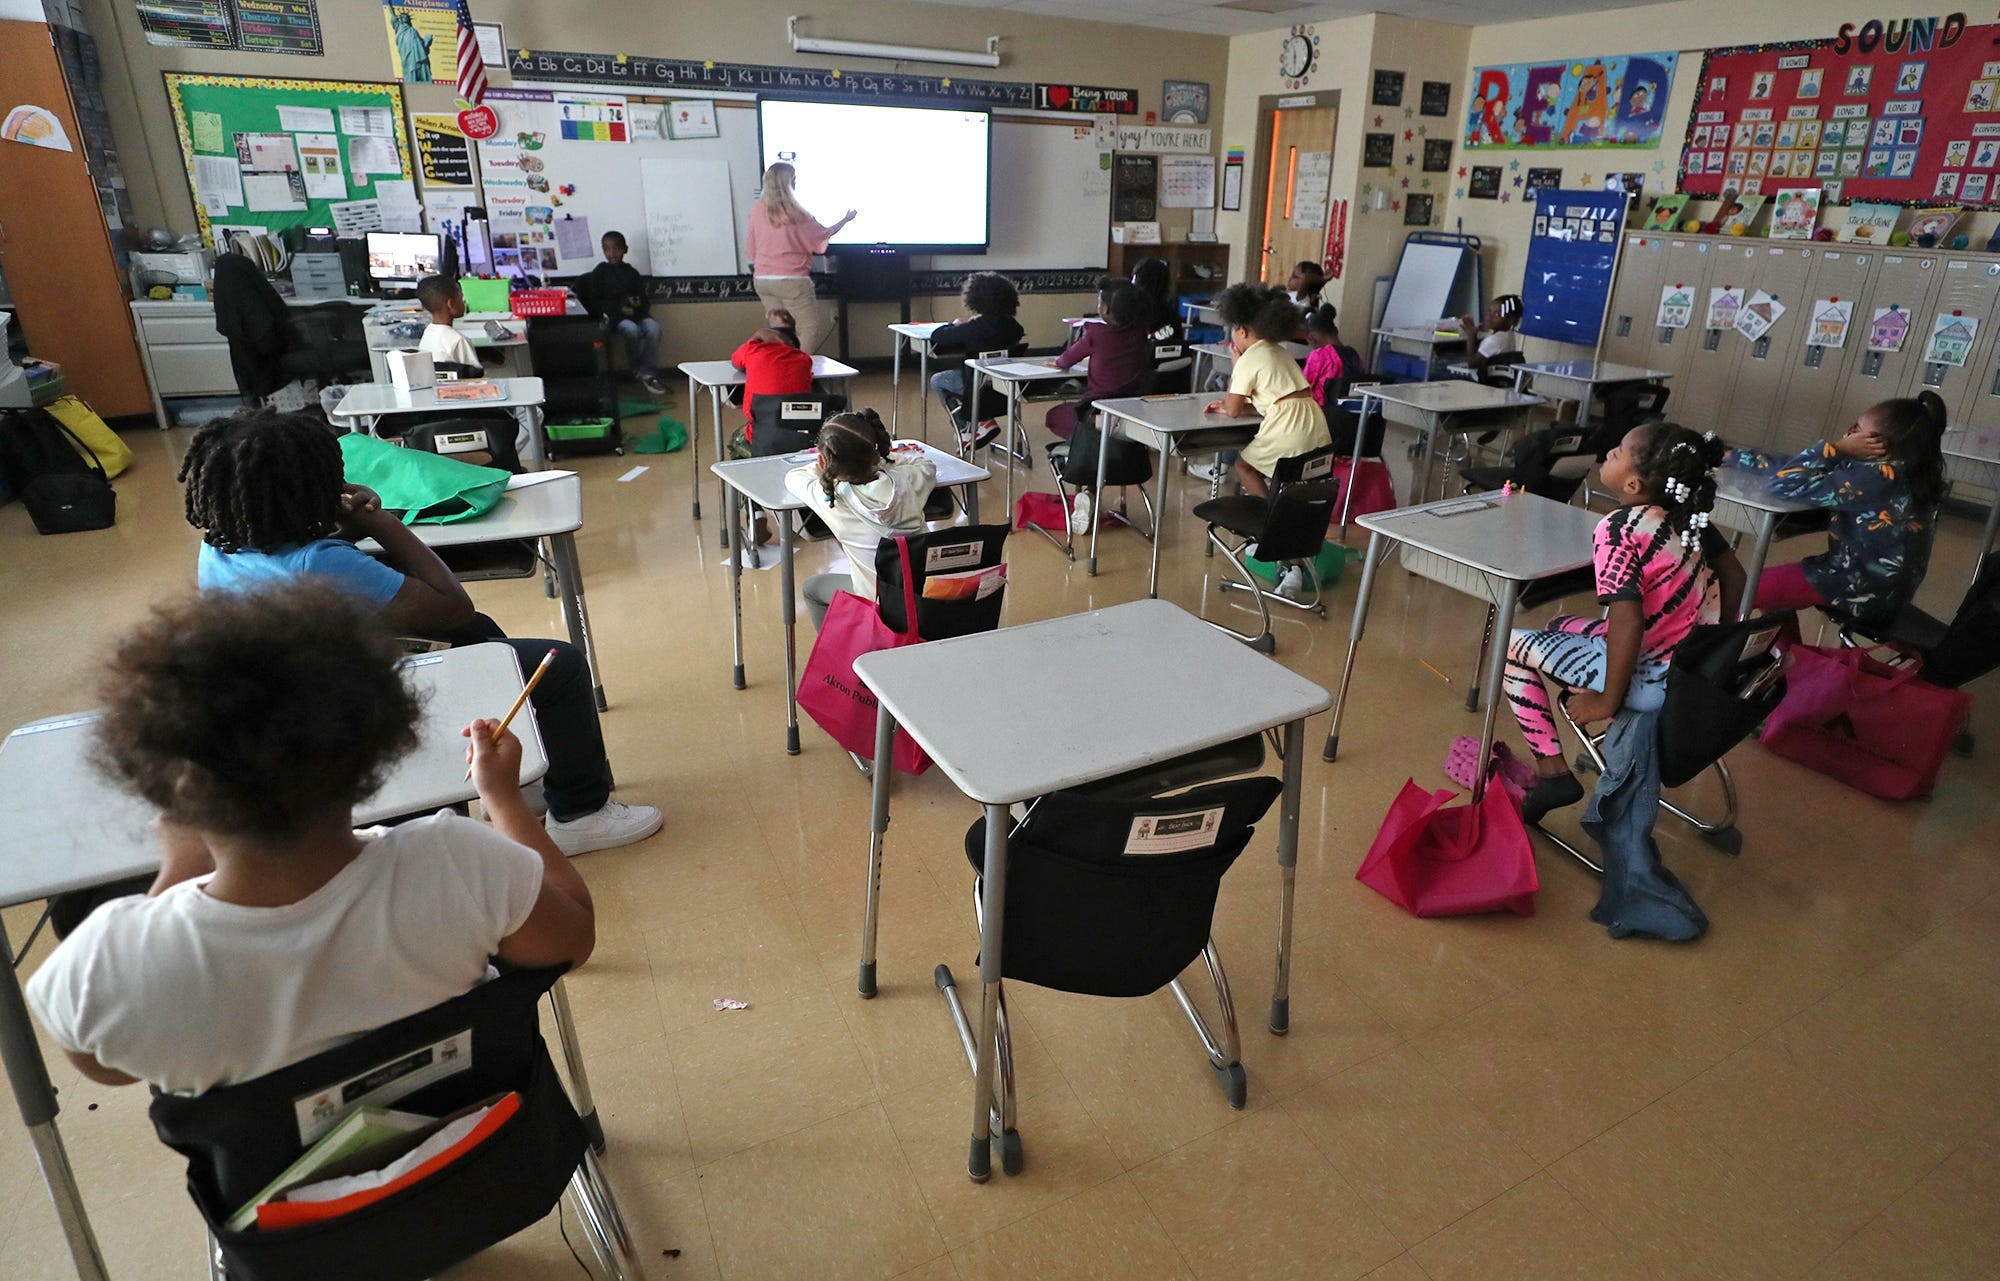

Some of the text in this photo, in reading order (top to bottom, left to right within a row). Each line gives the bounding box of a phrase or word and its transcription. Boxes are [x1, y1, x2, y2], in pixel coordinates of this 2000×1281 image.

[240, 0, 284, 13] Wednesday
[241, 11, 281, 24] Thursday
[243, 24, 272, 35] Friday
[1834, 12, 1968, 55] SOUND
[245, 35, 284, 47] Saturday
[512, 57, 534, 71] Aa
[539, 58, 558, 72] Bb
[563, 58, 582, 73] Cc
[587, 60, 606, 74] Dd
[612, 61, 628, 75] Ee
[634, 63, 648, 76] Ff
[655, 64, 675, 83] Gg
[680, 66, 698, 80] Hh
[703, 68, 711, 80] Ii
[719, 69, 732, 87] Jj
[739, 70, 754, 82] Kk
[760, 71, 773, 84] Ll
[780, 72, 801, 85] Mm
[804, 74, 820, 87] Nn
[823, 75, 840, 88] Oo
[845, 76, 858, 93] Pp
[862, 77, 880, 95] Qq
[883, 79, 895, 91] Rr
[919, 80, 929, 93] Tt
[953, 84, 966, 95] Vv
[1005, 88, 1016, 103] Yy
[1038, 86, 1050, 108] I
[1072, 86, 1129, 102] Being YOUR
[1479, 57, 1671, 144] READ
[1791, 108, 1807, 117] LONG
[1836, 106, 1855, 115] LONG
[1887, 103, 1907, 113] LONG
[416, 116, 438, 128] Helen
[1902, 121, 1920, 129] u_e
[484, 139, 517, 149] Monday
[1952, 141, 1965, 150] ar
[1984, 141, 1993, 150] ir
[1755, 153, 1765, 162] ey
[1822, 153, 1835, 161] oa
[1845, 152, 1858, 161] oe
[1898, 152, 1911, 160] ue
[488, 160, 520, 170] Tuesday
[1942, 174, 1955, 183] ur
[1970, 175, 1981, 184] er
[484, 179, 528, 189] Wednesday
[1825, 182, 1839, 190] ow
[491, 197, 526, 206] Thursday
[499, 209, 523, 219] Friday
[822, 674, 852, 696] Akron
